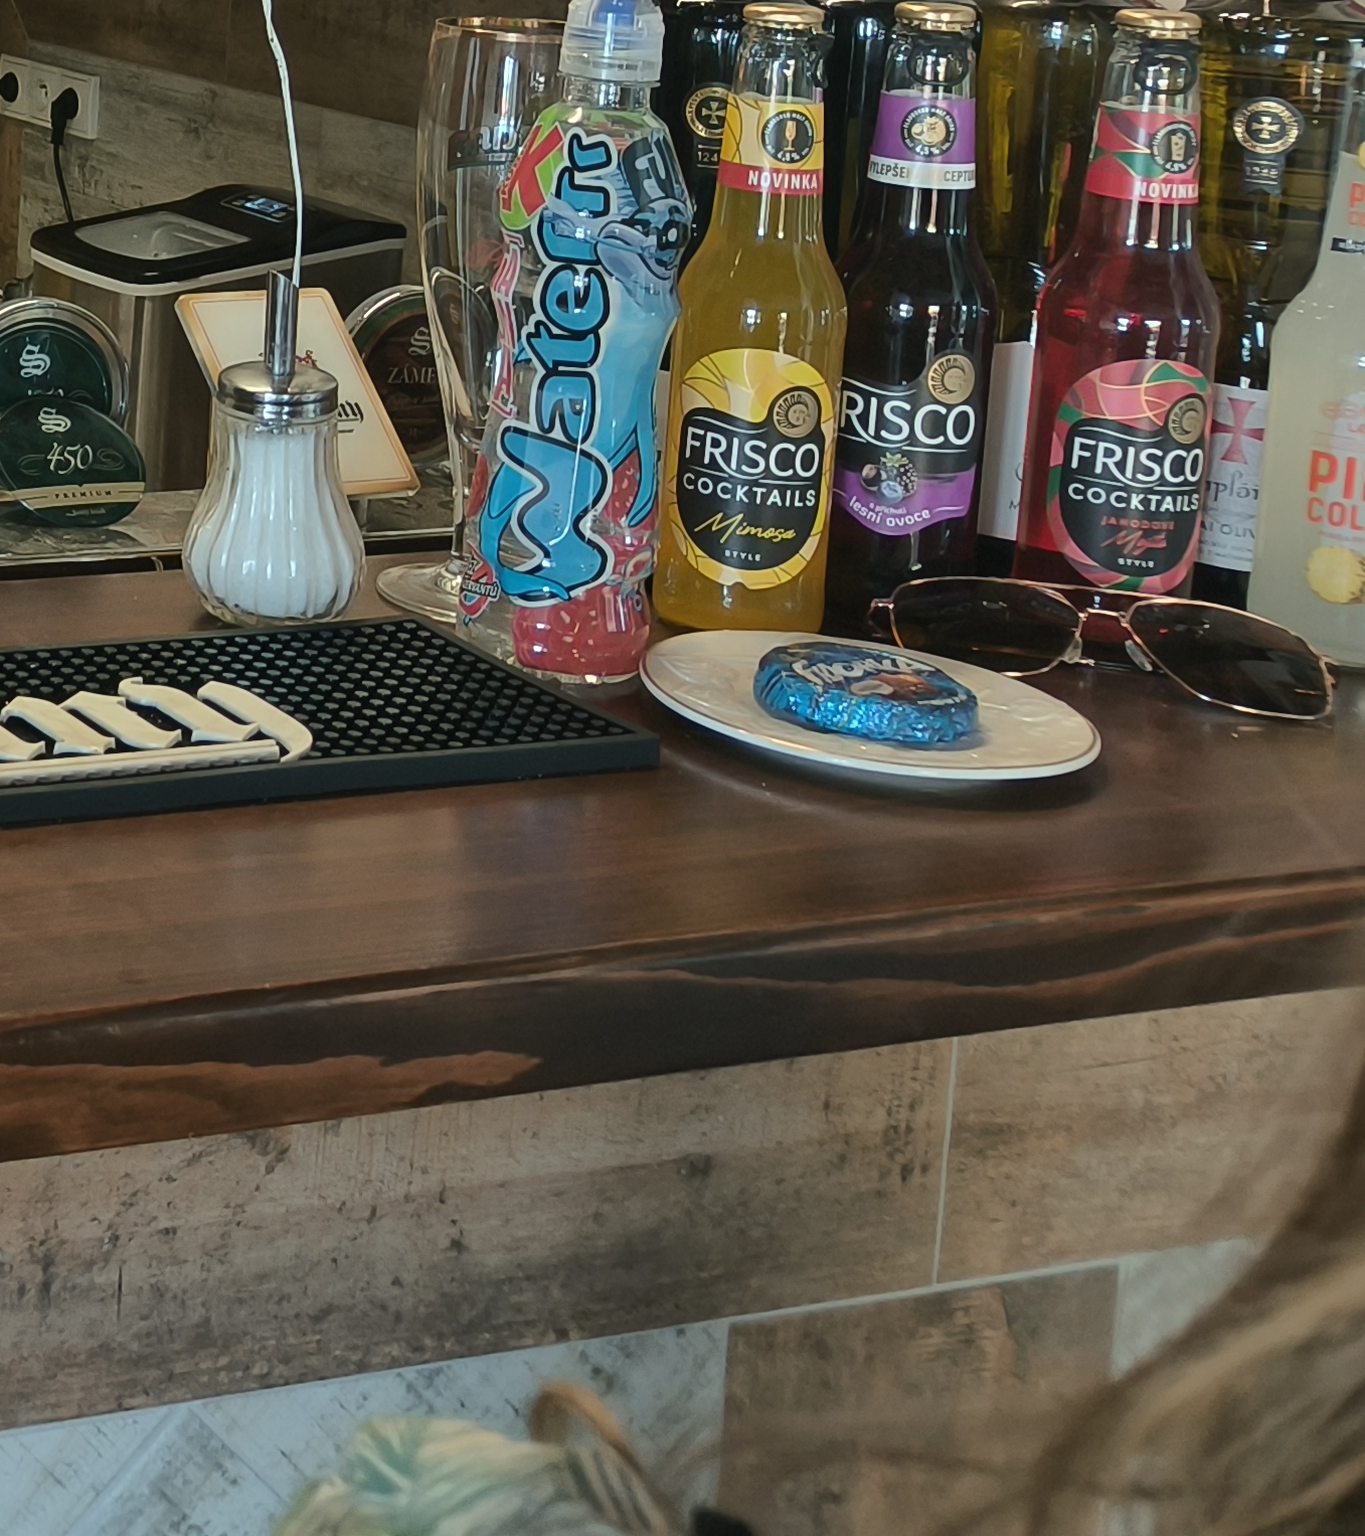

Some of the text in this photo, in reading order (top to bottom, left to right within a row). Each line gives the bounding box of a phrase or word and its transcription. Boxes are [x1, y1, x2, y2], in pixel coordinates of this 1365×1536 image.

[748, 170, 818, 190] NOVINKA
[387, 363, 436, 385] ZÁME
[841, 390, 976, 448] RISCO
[46, 441, 93, 476] 450
[684, 426, 820, 479] FRISCO
[1070, 436, 1204, 486] FRISCO
[682, 472, 816, 507] COCKTAILS
[1309, 449, 1365, 503] PI
[54, 489, 114, 500] PREMIUM
[849, 495, 931, 527] lesní ovoce
[1067, 482, 1200, 512] COCKTAILS
[694, 512, 797, 544] Mimosa
[1306, 496, 1365, 532] COL
[724, 549, 762, 563] STYLE
